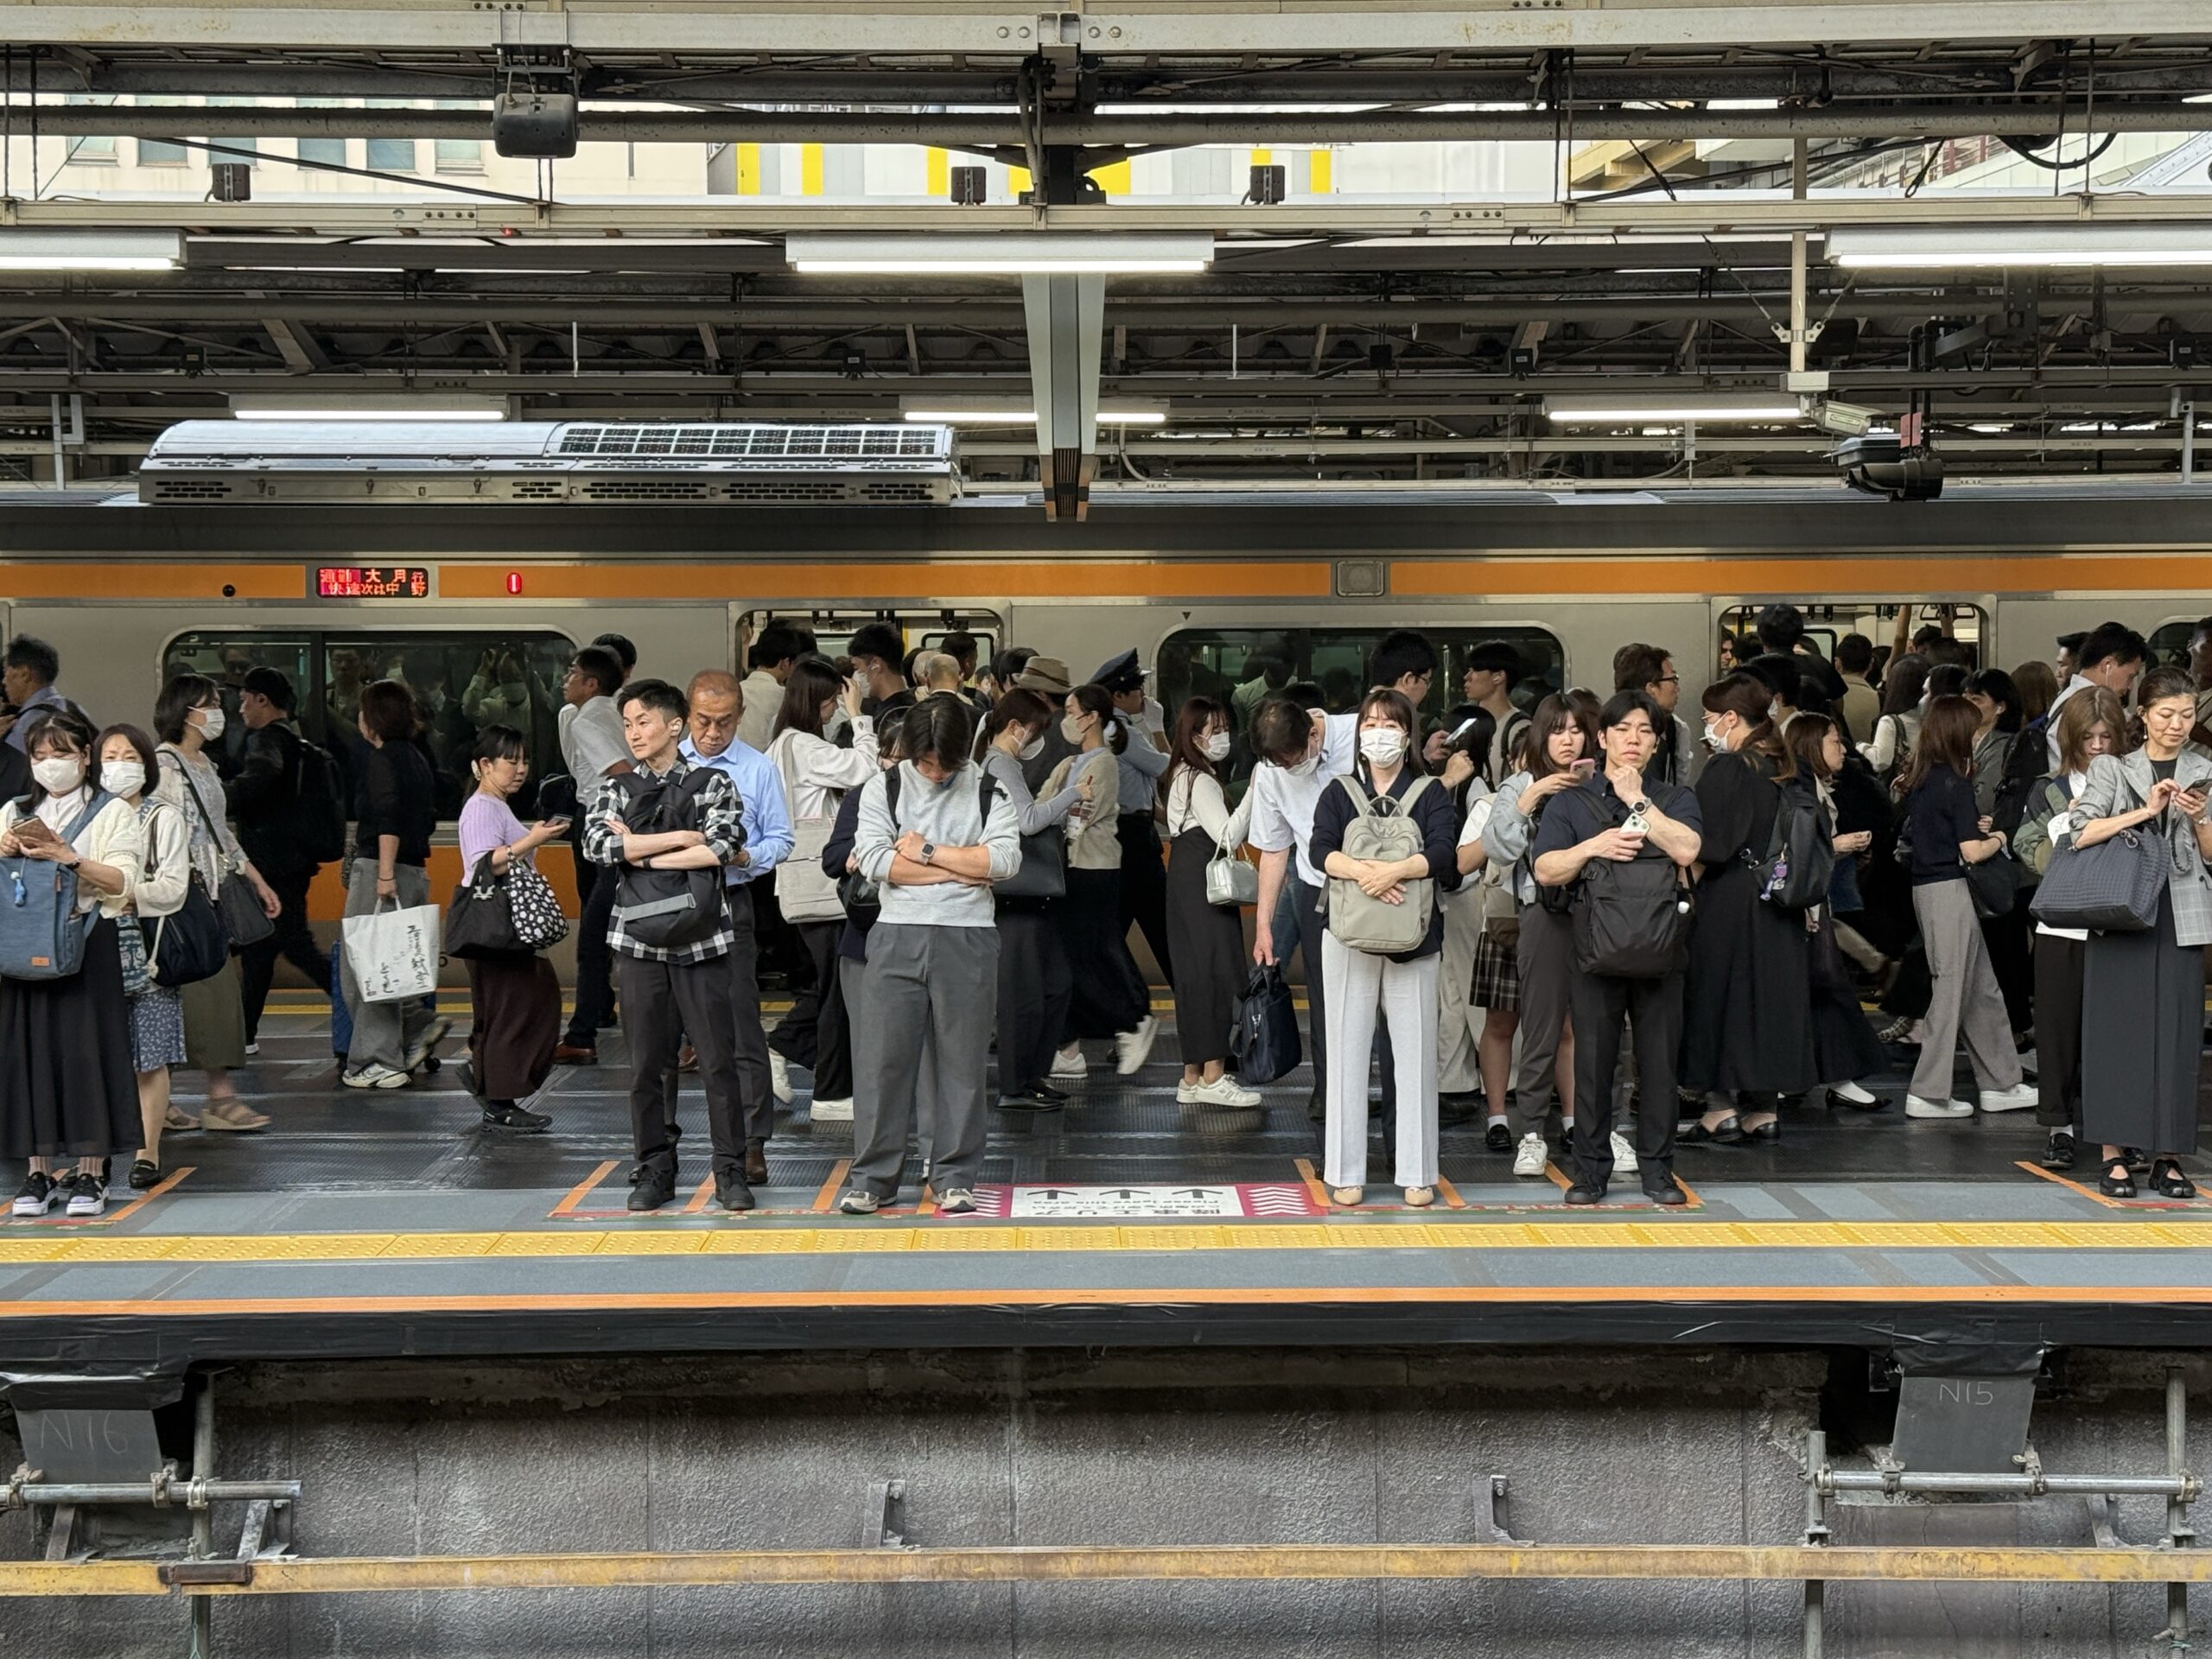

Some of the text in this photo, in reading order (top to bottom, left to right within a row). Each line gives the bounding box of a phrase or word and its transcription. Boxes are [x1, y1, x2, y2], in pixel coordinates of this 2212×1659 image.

[365, 569, 423, 583] 大月行
[361, 582, 425, 595] 次は中野
[1939, 1380, 1993, 1406] N15
[41, 1411, 128, 1455] N16
